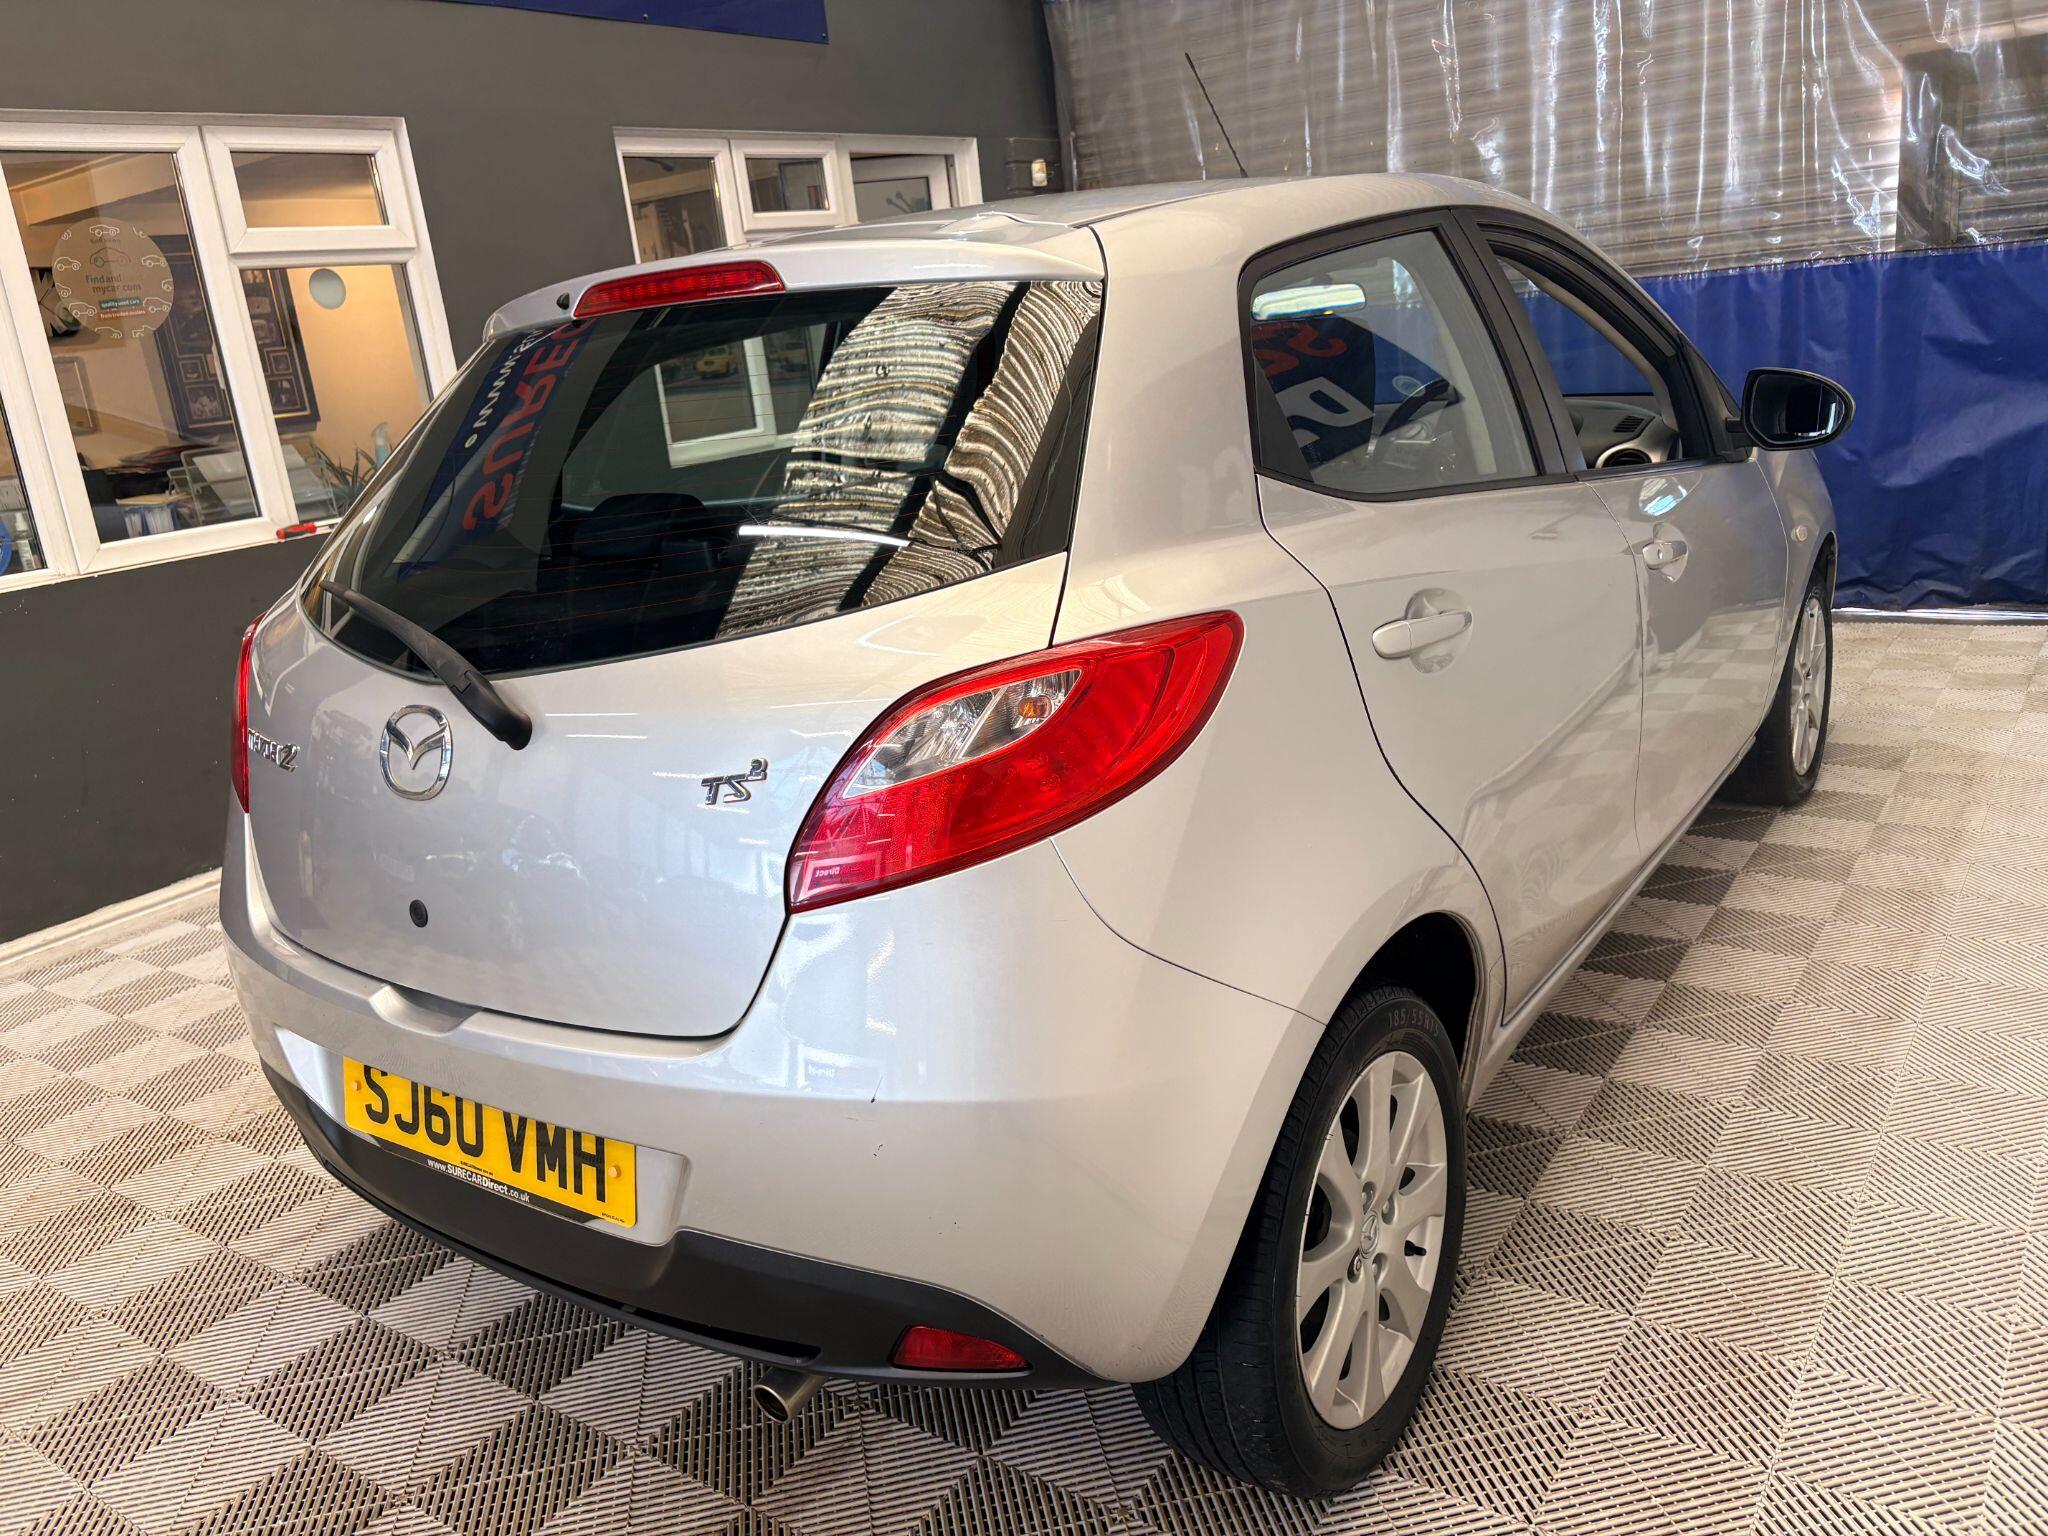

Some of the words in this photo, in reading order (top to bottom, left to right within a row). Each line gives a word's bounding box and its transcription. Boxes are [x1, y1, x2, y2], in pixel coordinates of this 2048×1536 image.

[363, 1064, 484, 1158] SJ60
[502, 1110, 606, 1203] VMH
[427, 1158, 531, 1203] www.SURECARDirect.co.uk
